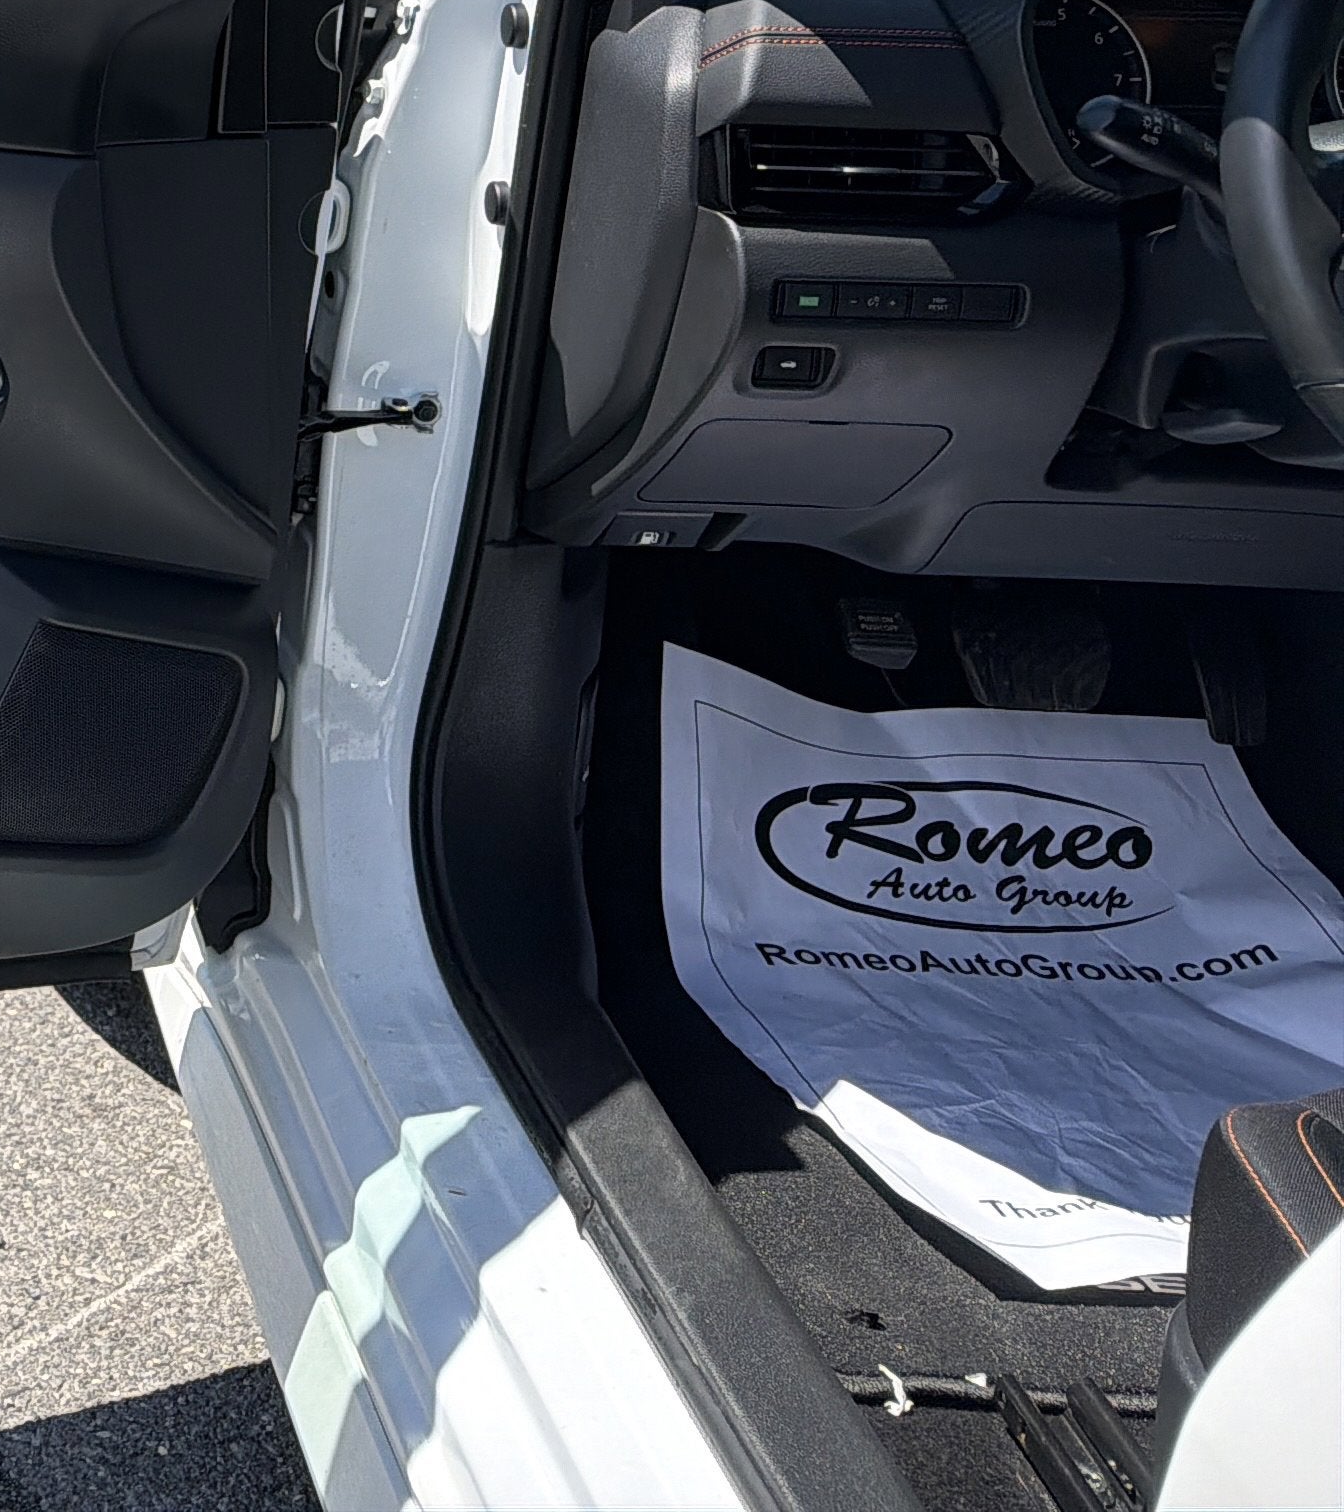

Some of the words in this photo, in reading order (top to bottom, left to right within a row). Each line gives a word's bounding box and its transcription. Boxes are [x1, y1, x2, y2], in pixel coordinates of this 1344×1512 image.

[1057, 8, 1066, 20] 5
[1094, 32, 1103, 45] 6
[1114, 74, 1122, 86] 7
[809, 782, 1153, 870] Romeo
[867, 867, 976, 902] Auto
[996, 875, 1134, 918] Group
[755, 943, 1280, 984] RomeoAutoGroup.com
[978, 1199, 1109, 1219] Thank
